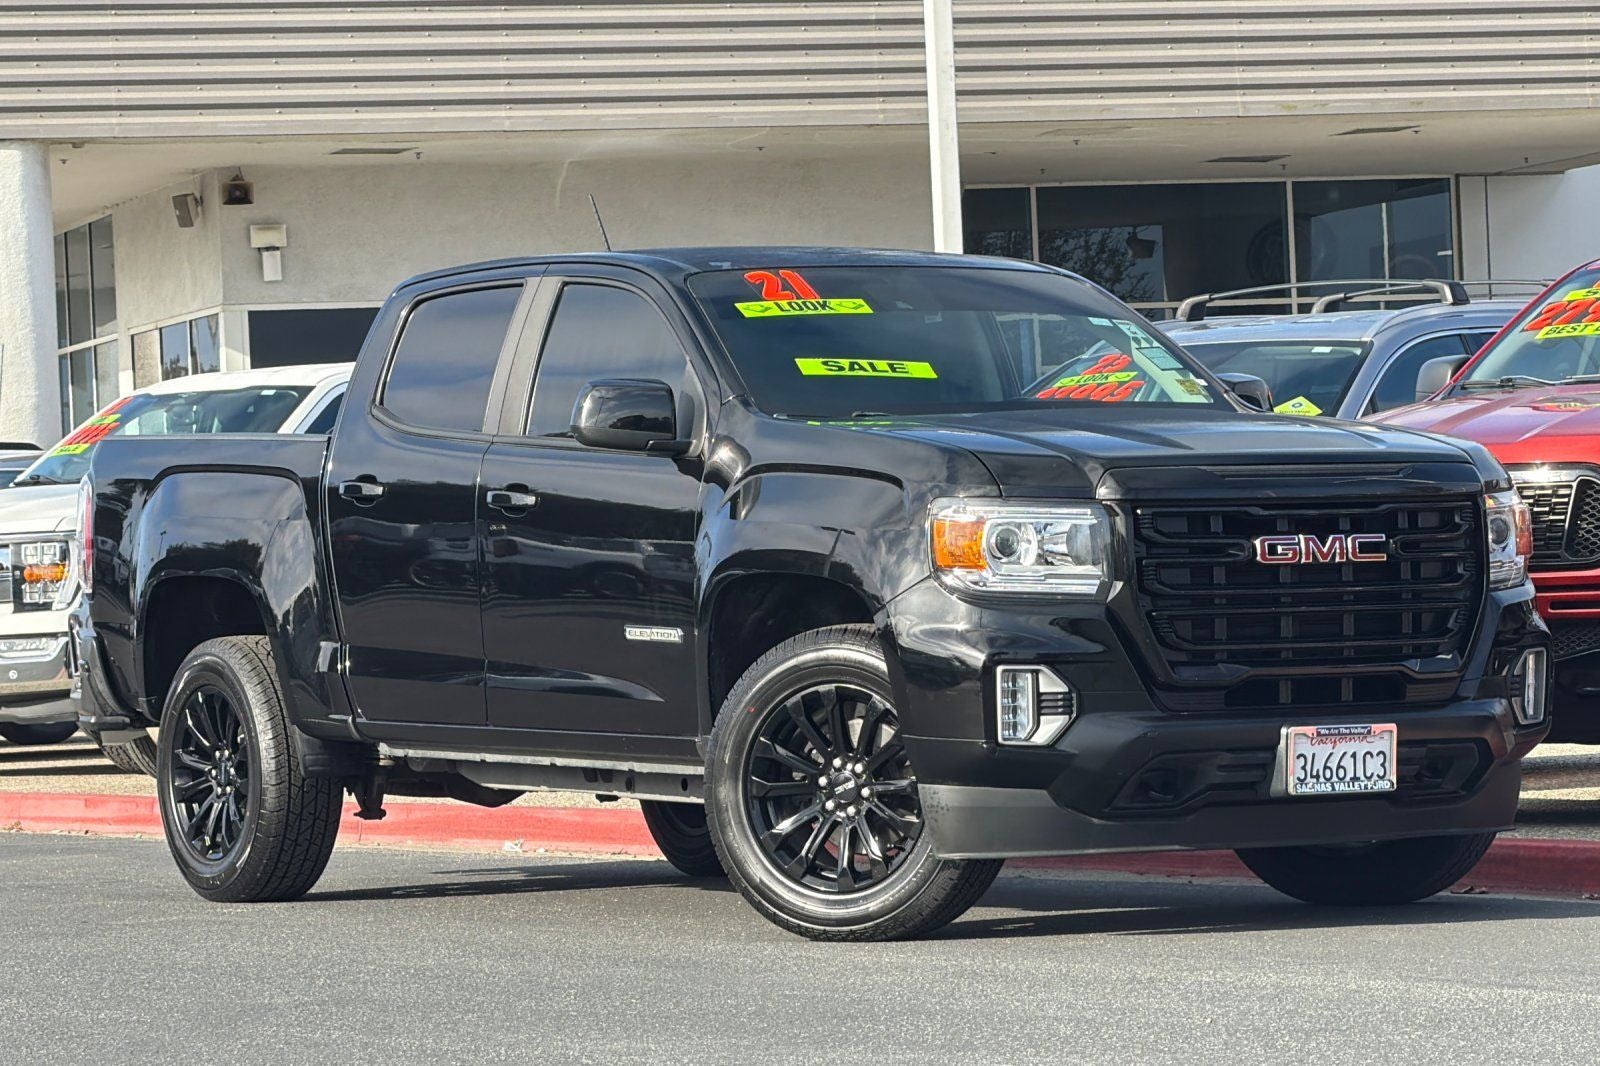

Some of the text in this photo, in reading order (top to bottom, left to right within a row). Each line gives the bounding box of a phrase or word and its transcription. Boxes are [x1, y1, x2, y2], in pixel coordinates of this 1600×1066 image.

[744, 269, 821, 301] 21
[773, 300, 837, 312] LOOK
[1542, 324, 1595, 336] BEST
[820, 360, 910, 374] SALE
[1081, 353, 1132, 375] 23
[1075, 374, 1113, 384] LOOK
[1253, 534, 1387, 564] GMC
[627, 629, 677, 640] ELEVATION
[1296, 750, 1387, 783] 34661C3
[1333, 781, 1367, 792] VALLEY
